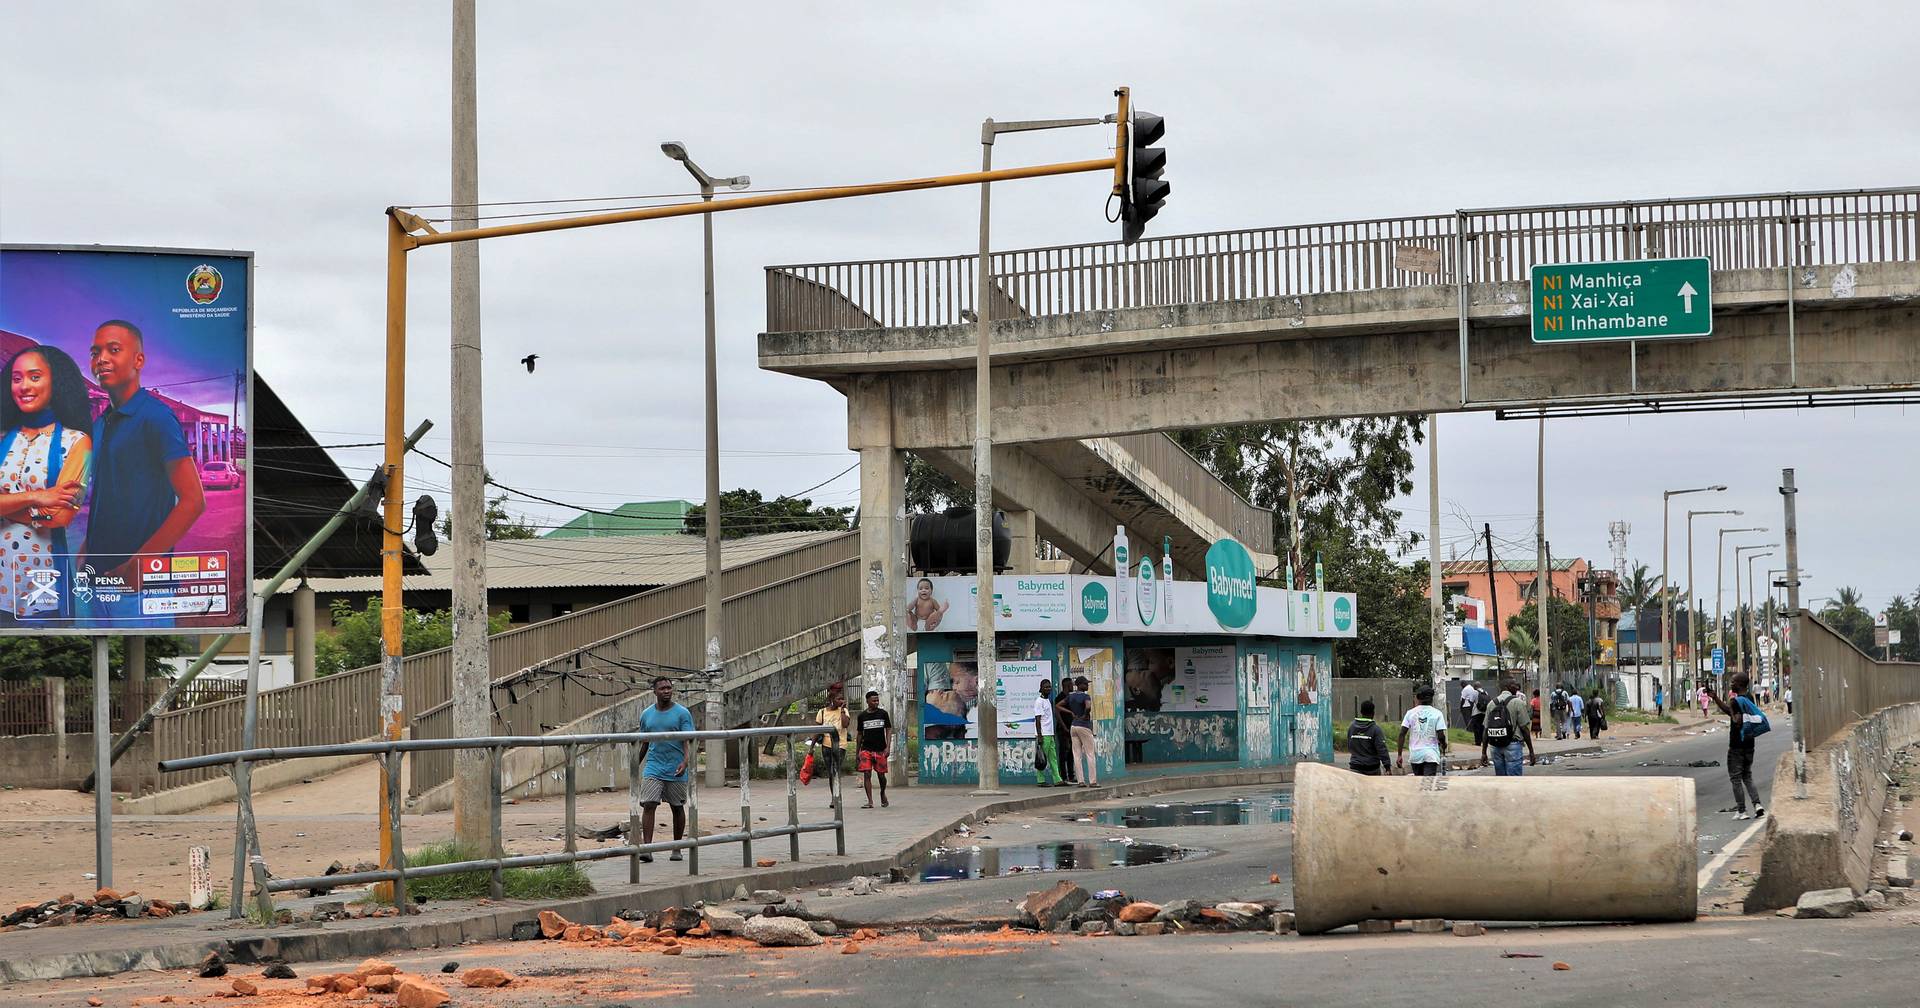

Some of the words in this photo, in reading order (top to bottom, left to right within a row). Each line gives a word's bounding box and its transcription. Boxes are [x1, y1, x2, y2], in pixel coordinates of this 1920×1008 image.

[1542, 275, 1562, 290] N1
[1570, 272, 1642, 290] Manhiça
[1543, 295, 1563, 310] N1
[1571, 291, 1634, 309] Xai-Xai
[1543, 315, 1564, 331] N1
[1571, 312, 1668, 331] Inhambane
[95, 577, 125, 585] PENSA
[1018, 580, 1065, 593] Babymed
[1210, 566, 1252, 606] Babymed
[1083, 595, 1107, 614] Babymed
[1335, 608, 1350, 622] Babymed
[1192, 647, 1224, 655] Babymed
[1002, 664, 1037, 674] Babymed
[1488, 728, 1506, 736] NIKE
